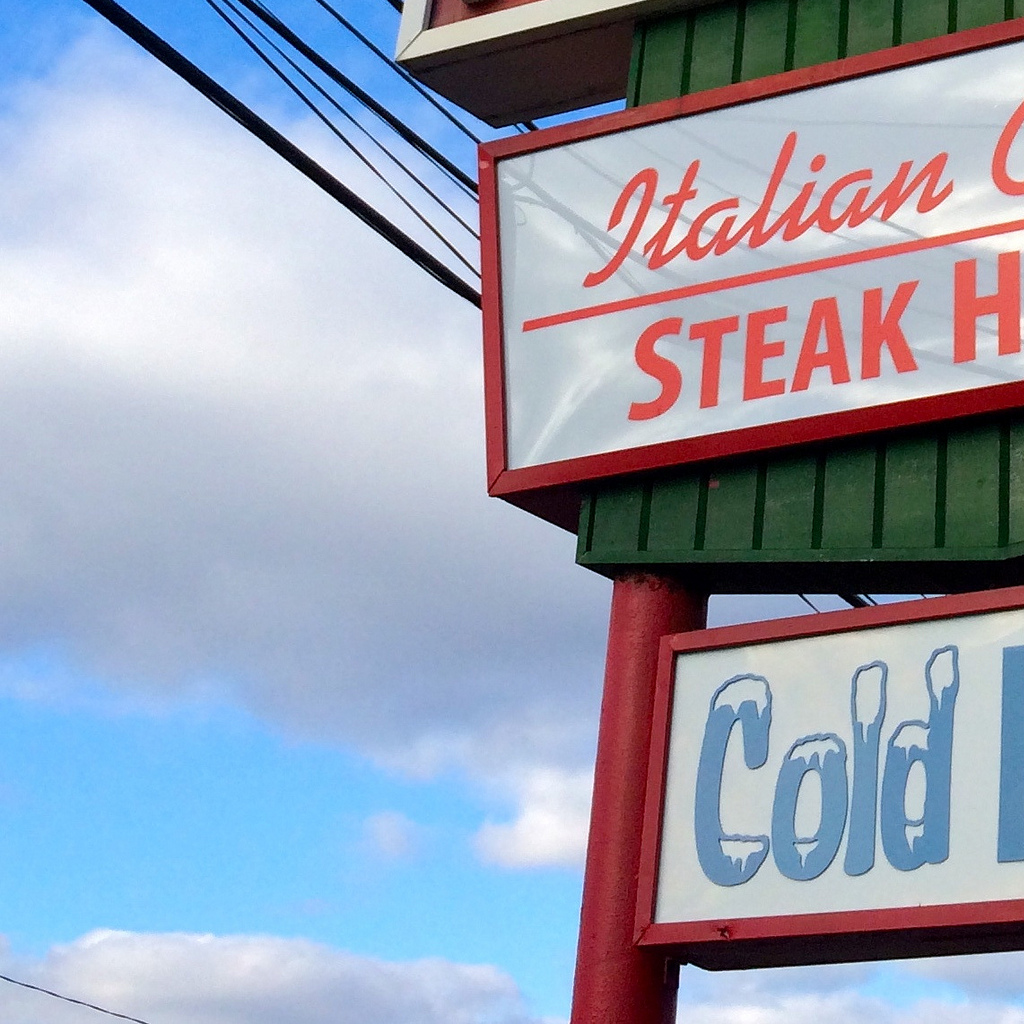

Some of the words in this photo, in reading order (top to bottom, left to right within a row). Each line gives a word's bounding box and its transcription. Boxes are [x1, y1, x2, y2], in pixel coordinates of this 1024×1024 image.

[583, 131, 954, 288] Italian
[627, 280, 921, 422] STEAK
[694, 644, 960, 887] Cold
